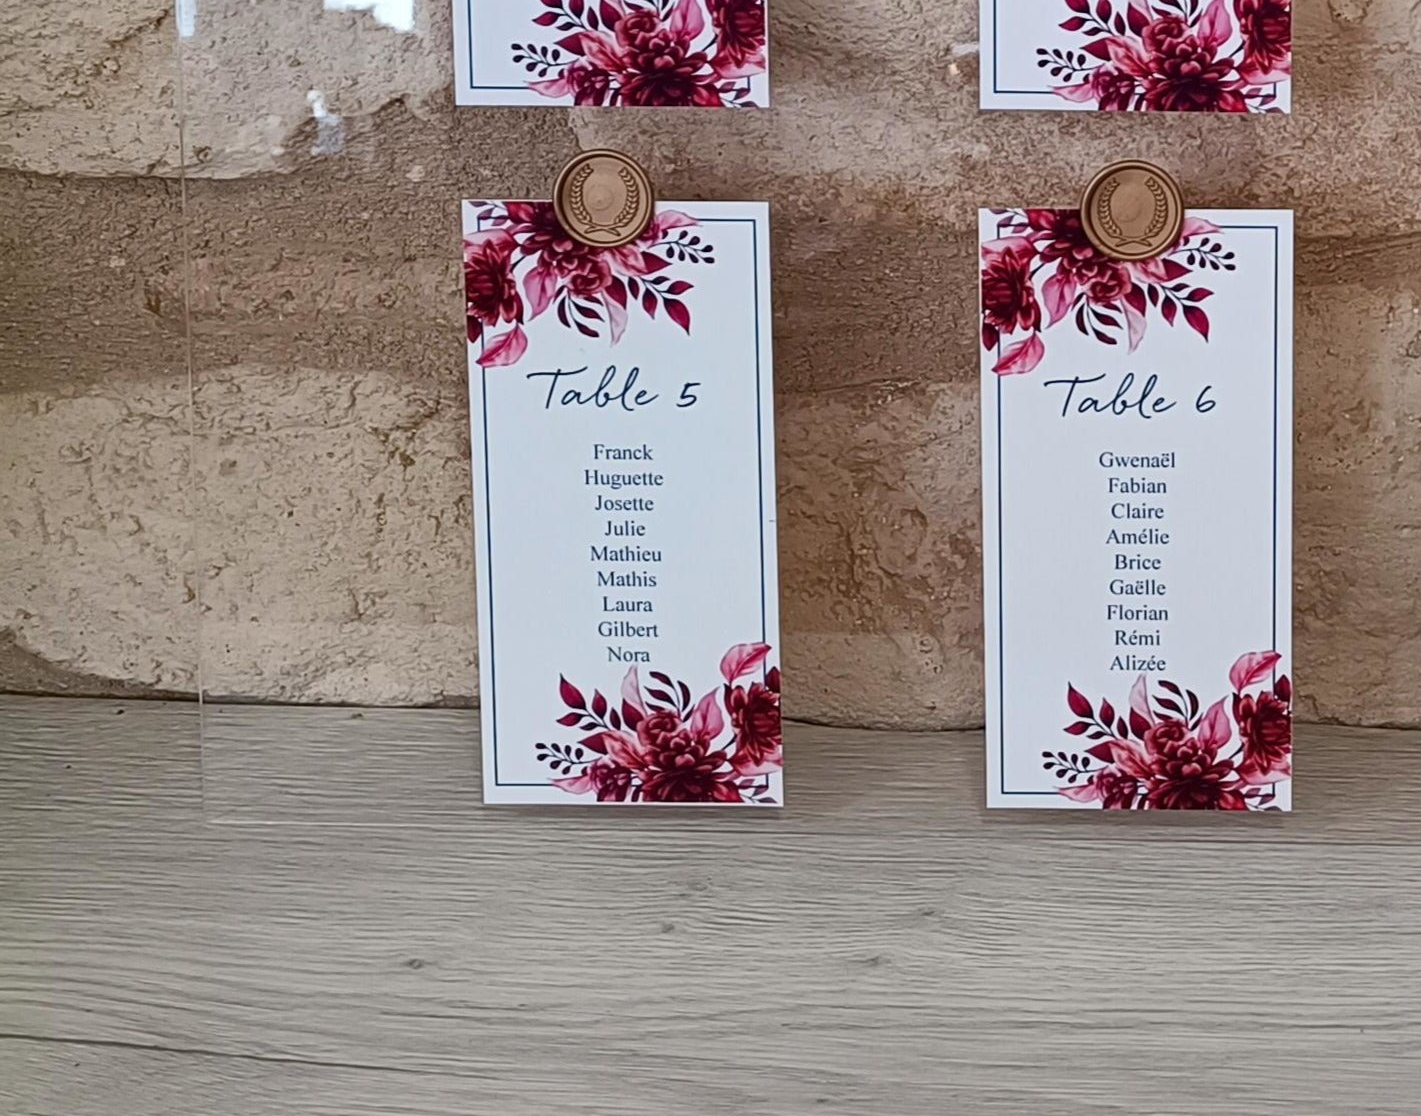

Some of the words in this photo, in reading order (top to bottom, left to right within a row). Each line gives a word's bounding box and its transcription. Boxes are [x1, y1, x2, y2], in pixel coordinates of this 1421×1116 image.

[526, 365, 659, 411] Table
[676, 382, 701, 407] 5
[1043, 372, 1177, 419] Table
[1196, 385, 1216, 413] 6
[594, 444, 653, 460] Franck
[1099, 452, 1175, 468] Gwenaël
[584, 469, 663, 490] Huguette
[1109, 477, 1166, 494] Fabian
[595, 495, 654, 511] Josette
[1111, 503, 1164, 519] Claire
[605, 520, 645, 536] Julie
[1106, 529, 1169, 544] Amélie
[591, 546, 661, 562] Mathieu
[1115, 554, 1161, 570] Brice
[597, 571, 657, 587] Mathis
[1109, 579, 1166, 596] Gaëlle
[603, 596, 653, 612] Laura
[1107, 604, 1168, 621] Florian
[598, 621, 658, 637] Gilbert
[1115, 630, 1160, 646] Rémi
[607, 647, 650, 662] Nora
[1110, 655, 1166, 671] Alizée
